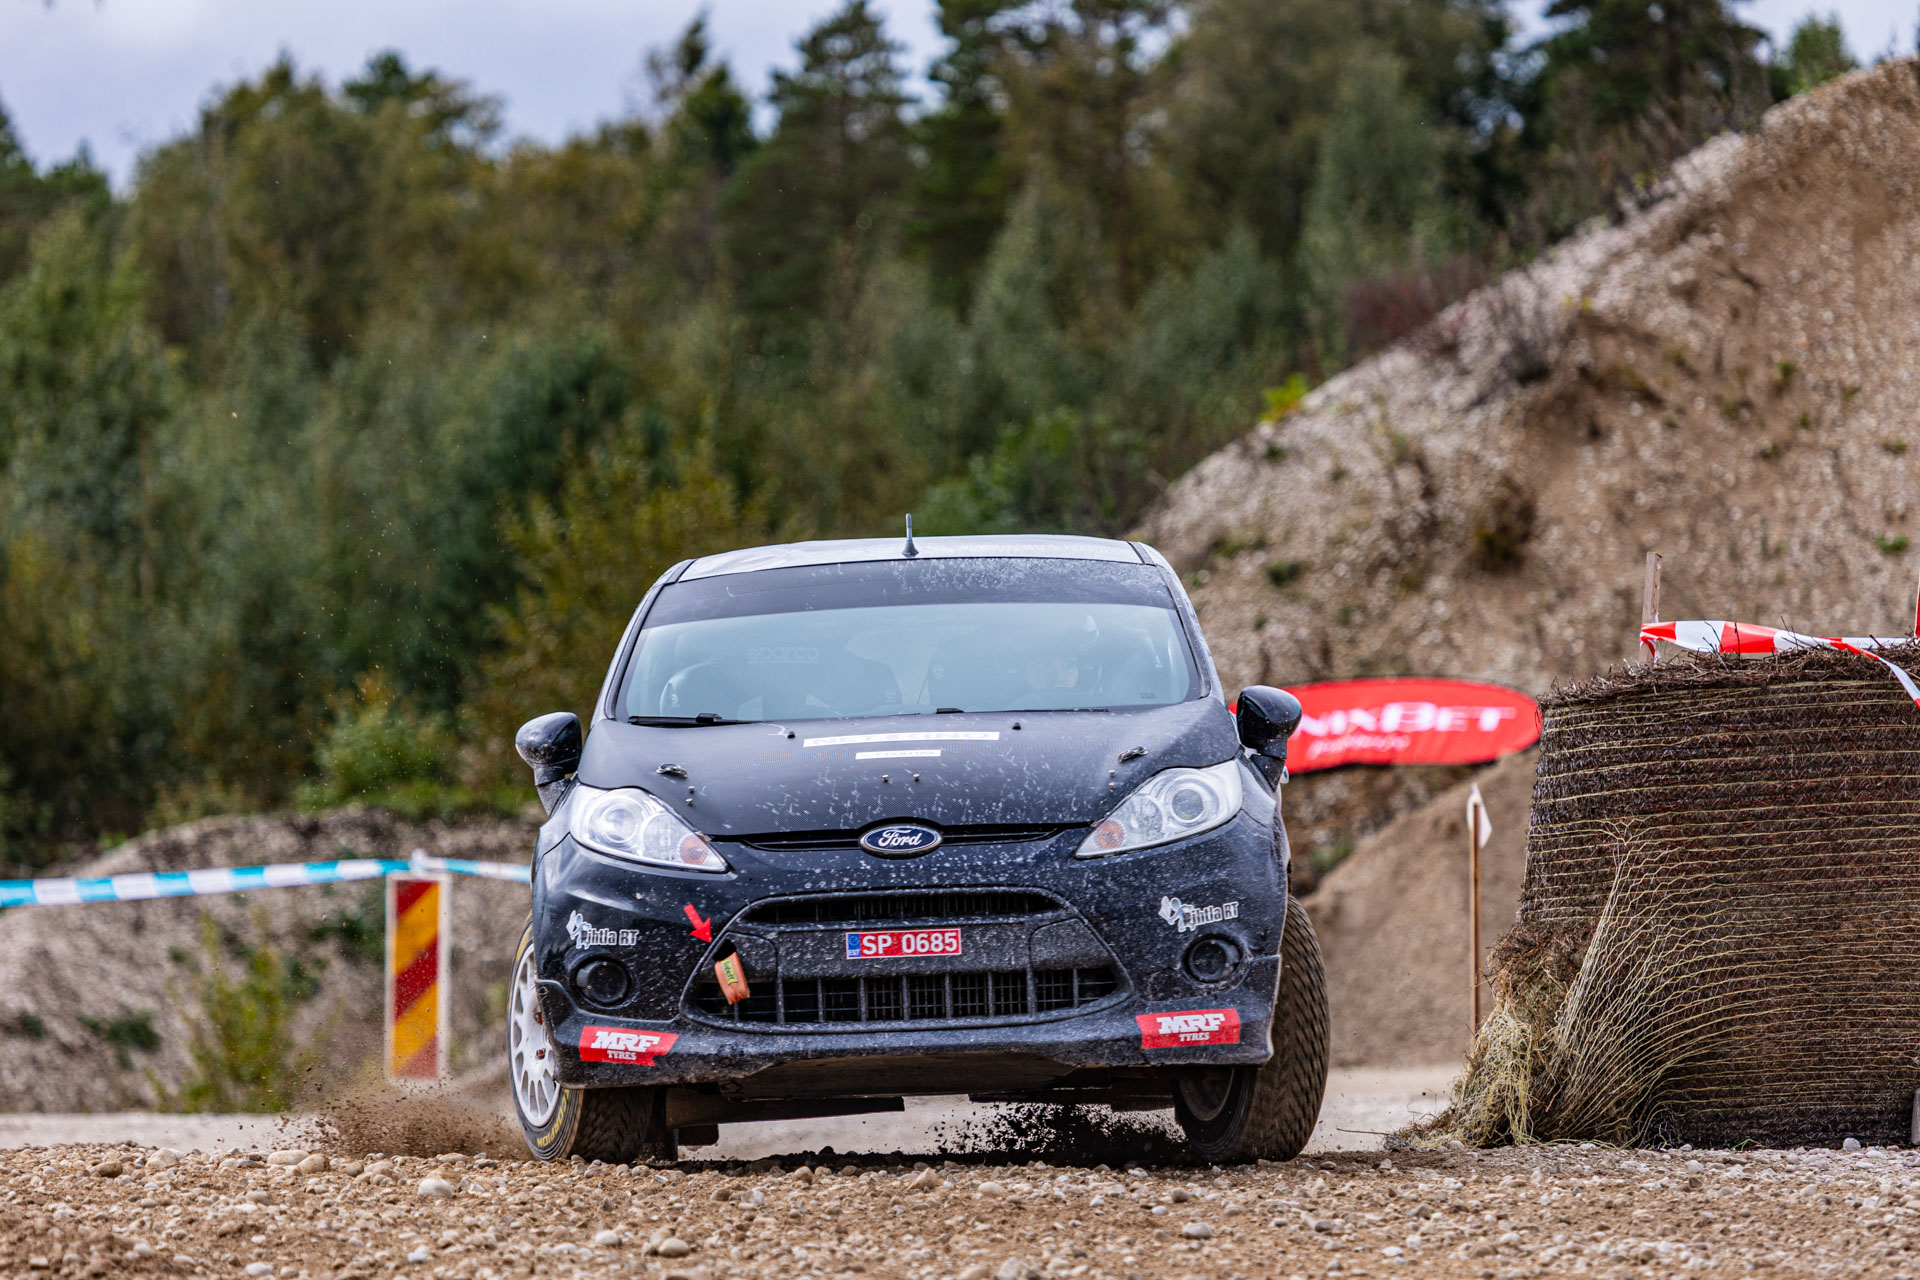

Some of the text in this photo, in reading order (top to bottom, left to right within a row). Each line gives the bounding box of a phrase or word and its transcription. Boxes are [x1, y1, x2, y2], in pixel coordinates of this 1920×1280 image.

[878, 829, 922, 847] Ford
[1223, 901, 1239, 919] RT
[619, 930, 639, 945] RT
[862, 932, 957, 955] SP 0685
[1156, 1013, 1226, 1035] MRF
[590, 1031, 660, 1053] MRF
[1179, 1032, 1209, 1042] TYRES
[607, 1050, 636, 1060] TYRES
